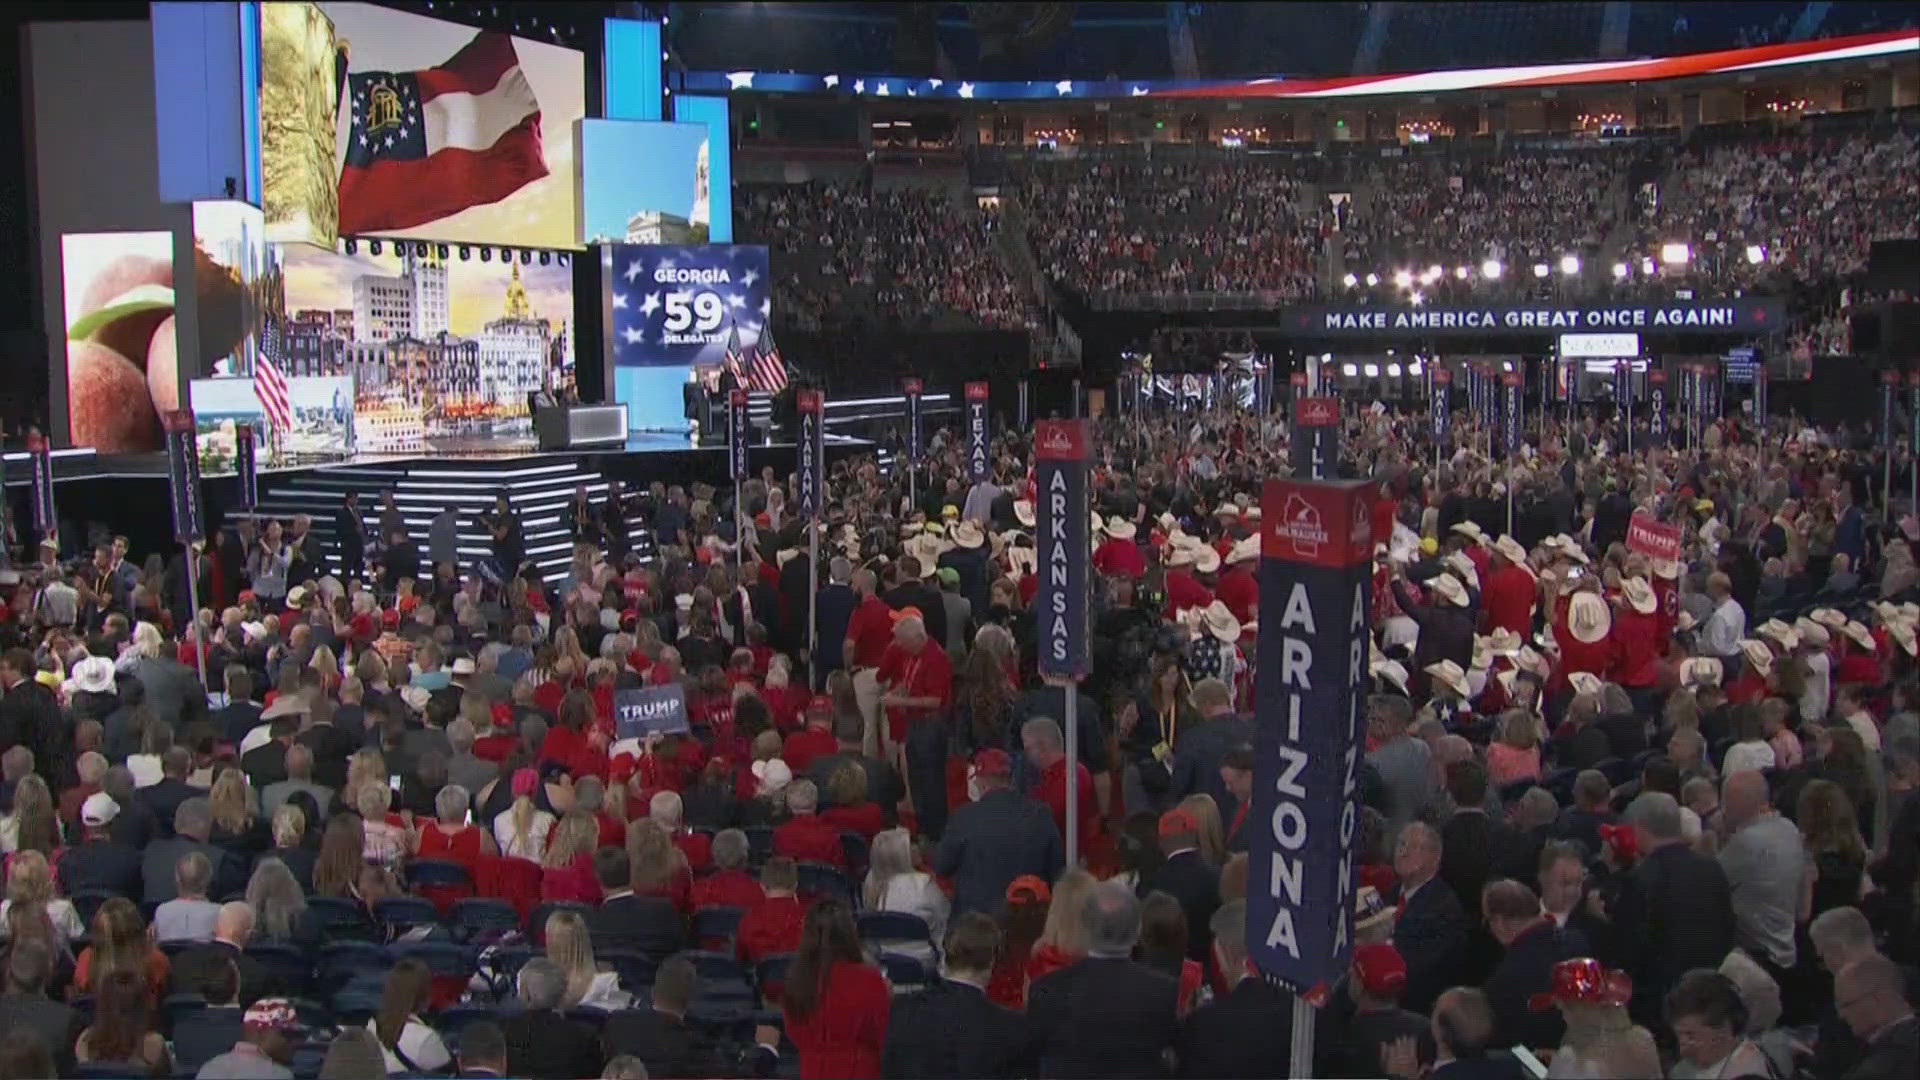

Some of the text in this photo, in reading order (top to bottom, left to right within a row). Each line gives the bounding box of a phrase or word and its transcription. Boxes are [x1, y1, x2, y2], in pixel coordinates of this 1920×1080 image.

[654, 269, 730, 283] GEORGIA
[664, 292, 723, 332] 59
[1326, 309, 1733, 329] MAKE AMERICA GREAT ONCE AGAIN!
[664, 334, 724, 345] DELEGATES
[1435, 389, 1445, 435] MAINE
[1651, 389, 1662, 434] GUAM
[736, 407, 745, 474] NEW YORK
[802, 413, 812, 509] ALABAMA
[972, 404, 985, 474] TEXAS
[181, 432, 198, 534] CALIFORNIA
[1633, 526, 1677, 548] TRUMP
[1050, 469, 1068, 661] ARKANSAS
[620, 699, 680, 720] TRUMP
[1266, 582, 1316, 959] ARIZONA
[1333, 582, 1364, 959] ARIZONA
